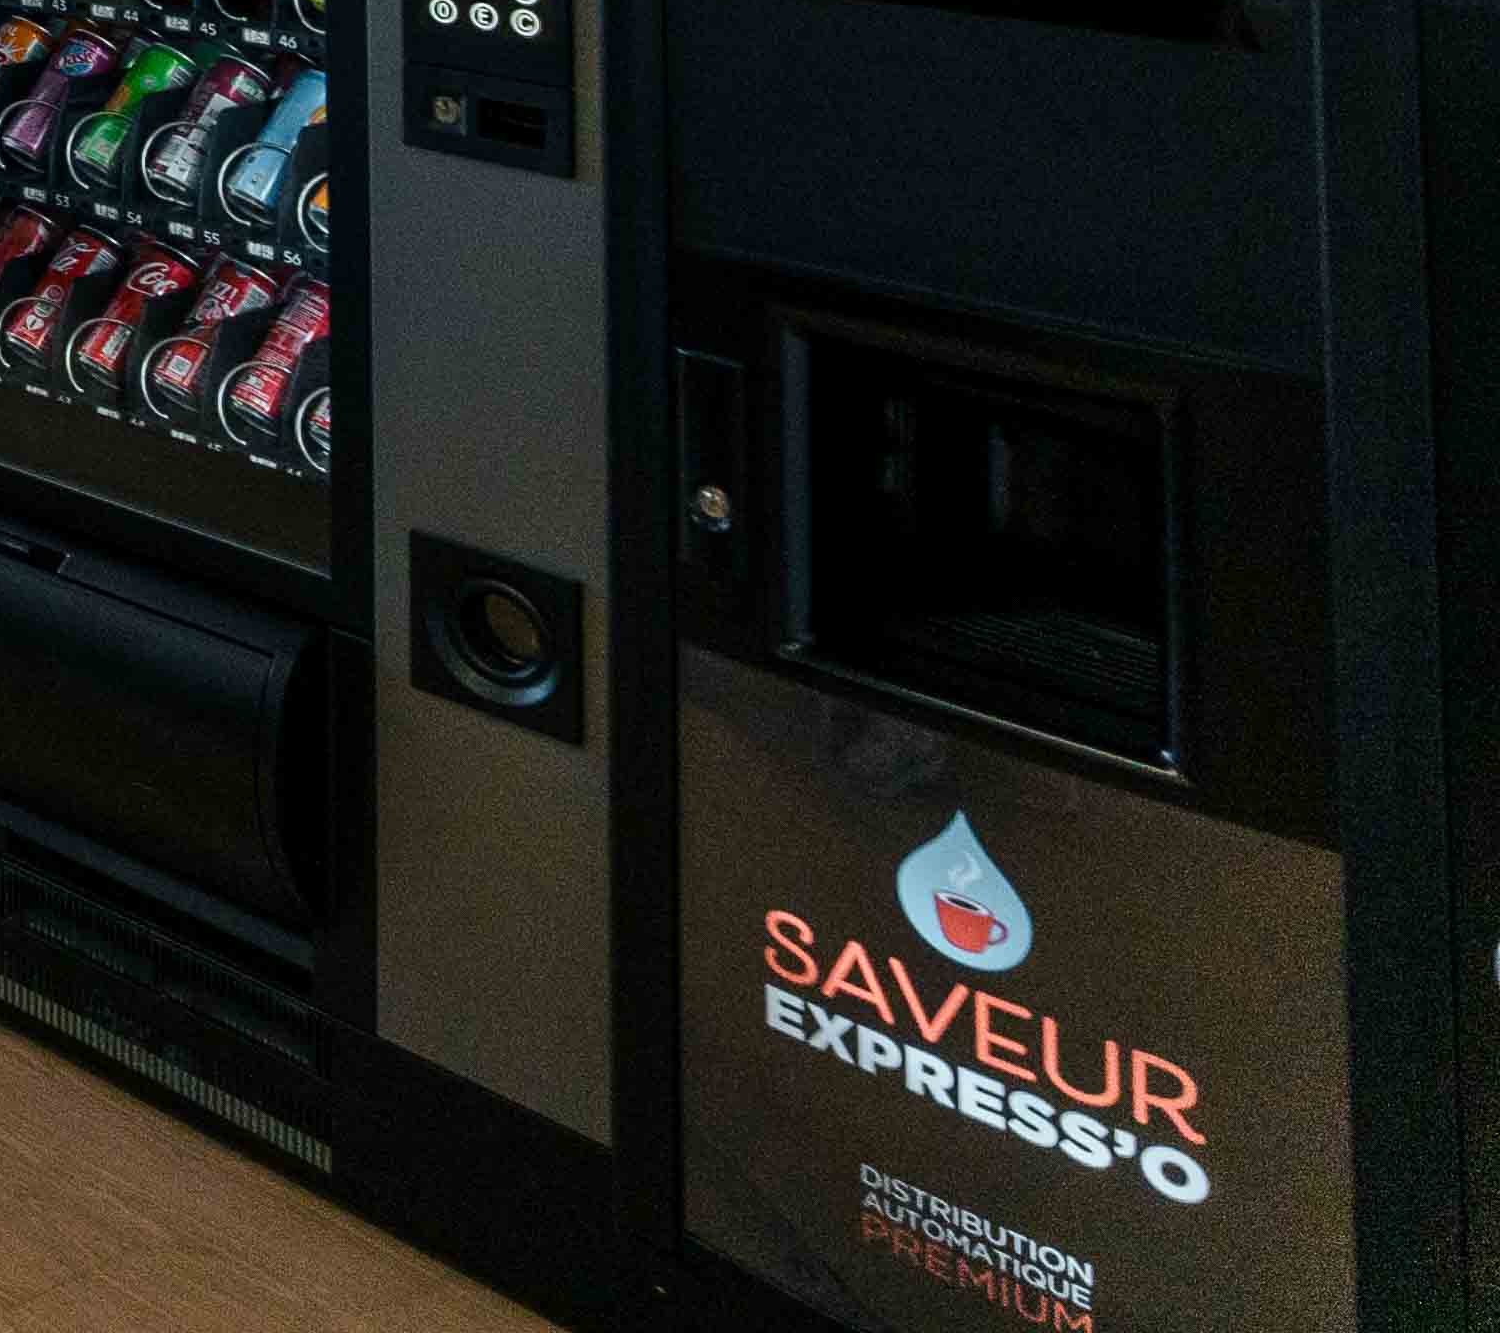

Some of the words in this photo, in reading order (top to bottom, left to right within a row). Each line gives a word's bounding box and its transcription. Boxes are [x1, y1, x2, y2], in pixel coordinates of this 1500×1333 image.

[124, 9, 139, 22] 44
[200, 23, 217, 37] 45
[279, 35, 298, 49] 46
[55, 194, 70, 207] 53
[126, 211, 143, 225] 54
[203, 231, 220, 245] 55
[283, 251, 302, 266] 56
[763, 908, 1206, 1146] SAVEUR
[763, 983, 1210, 1205] EXPRESS'O
[859, 1163, 1094, 1287] DISTRIBUTION
[860, 1192, 1092, 1311] AUTOMATIQUE
[860, 1211, 1094, 1333] PREMIUM
